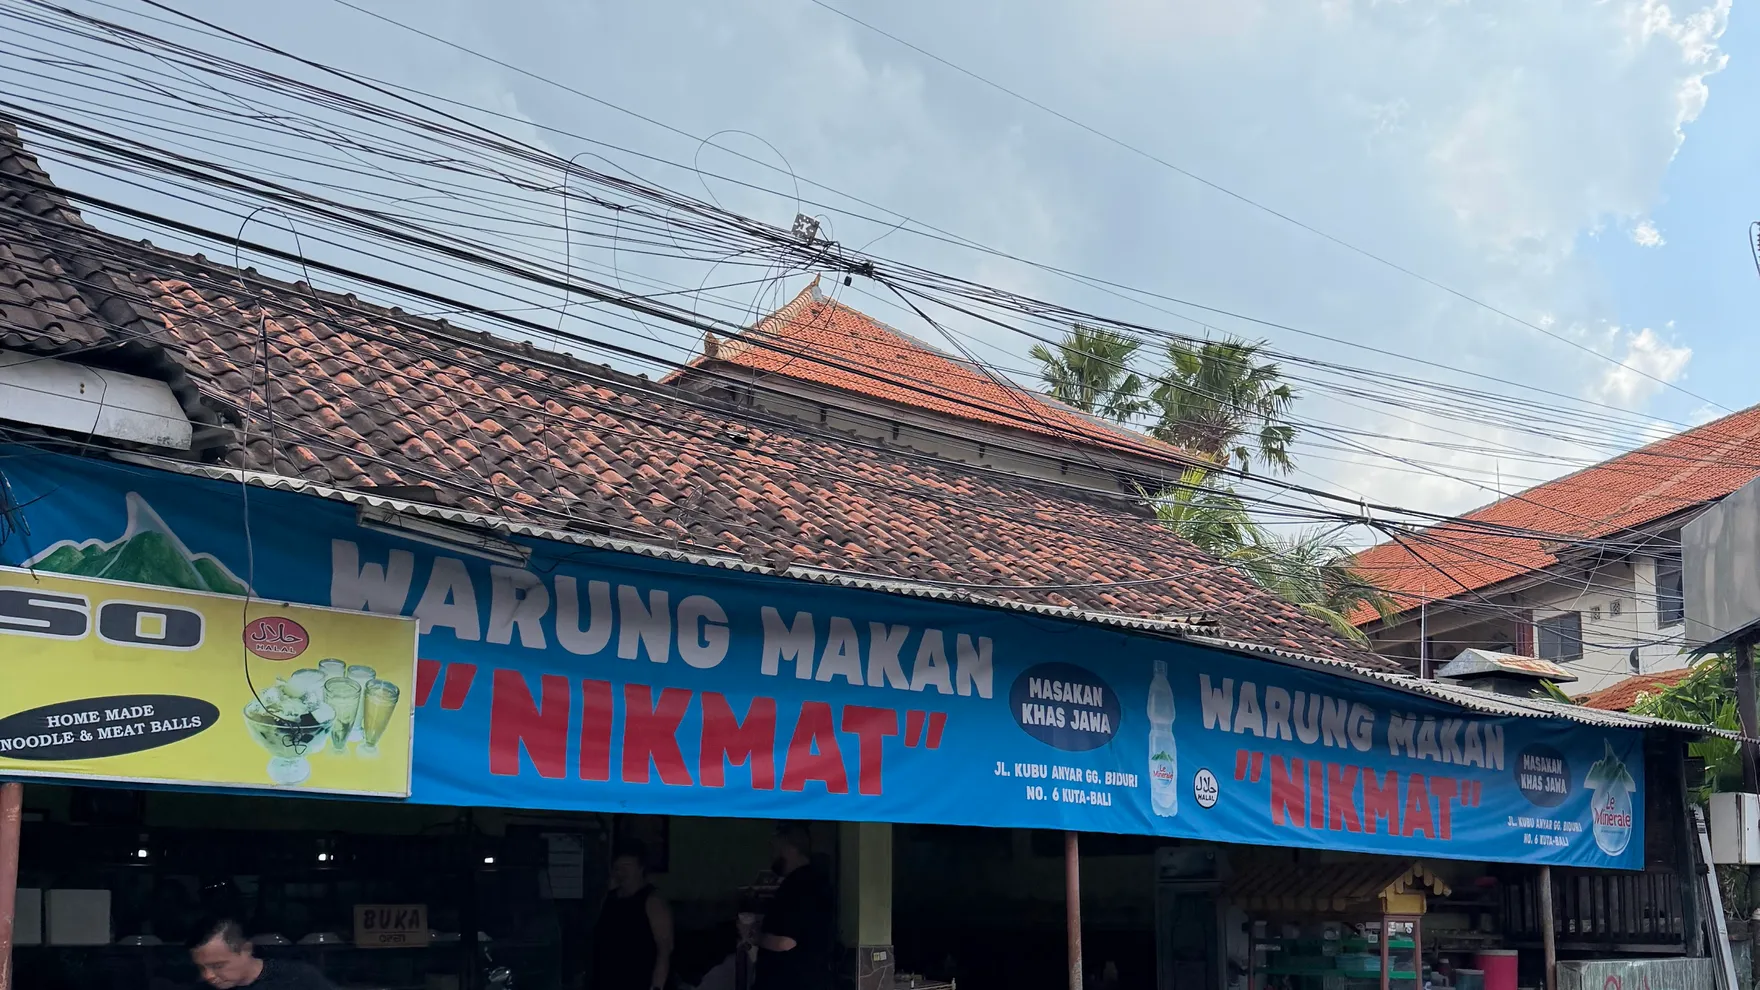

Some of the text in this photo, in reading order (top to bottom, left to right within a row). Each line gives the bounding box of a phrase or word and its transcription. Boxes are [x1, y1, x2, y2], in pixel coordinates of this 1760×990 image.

[330, 538, 994, 699] WARUNG MAKAN
[251, 622, 303, 643] حلال
[256, 644, 296, 654] HALAL
[1029, 677, 1103, 708] MASAKAN
[47, 705, 155, 728] HOME MADE
[1022, 703, 1112, 735] KHAS JAWA
[1200, 674, 1505, 770] WARUNG MAKAN
[0, 716, 202, 752] NOODLE & MEAT BALLS
[994, 761, 1138, 788] JL. KUBU ANYAR GG. BIDURI
[1523, 754, 1562, 775] MASAKAN
[1195, 776, 1217, 793] حلال
[1520, 773, 1567, 795] KHAS JAWA
[1026, 786, 1112, 807] NO. 6 KUTA-BALI
[1197, 794, 1215, 802] HALAL
[1606, 792, 1616, 810] Le
[1594, 808, 1632, 828] Minerale
[364, 909, 420, 930] BUKA
